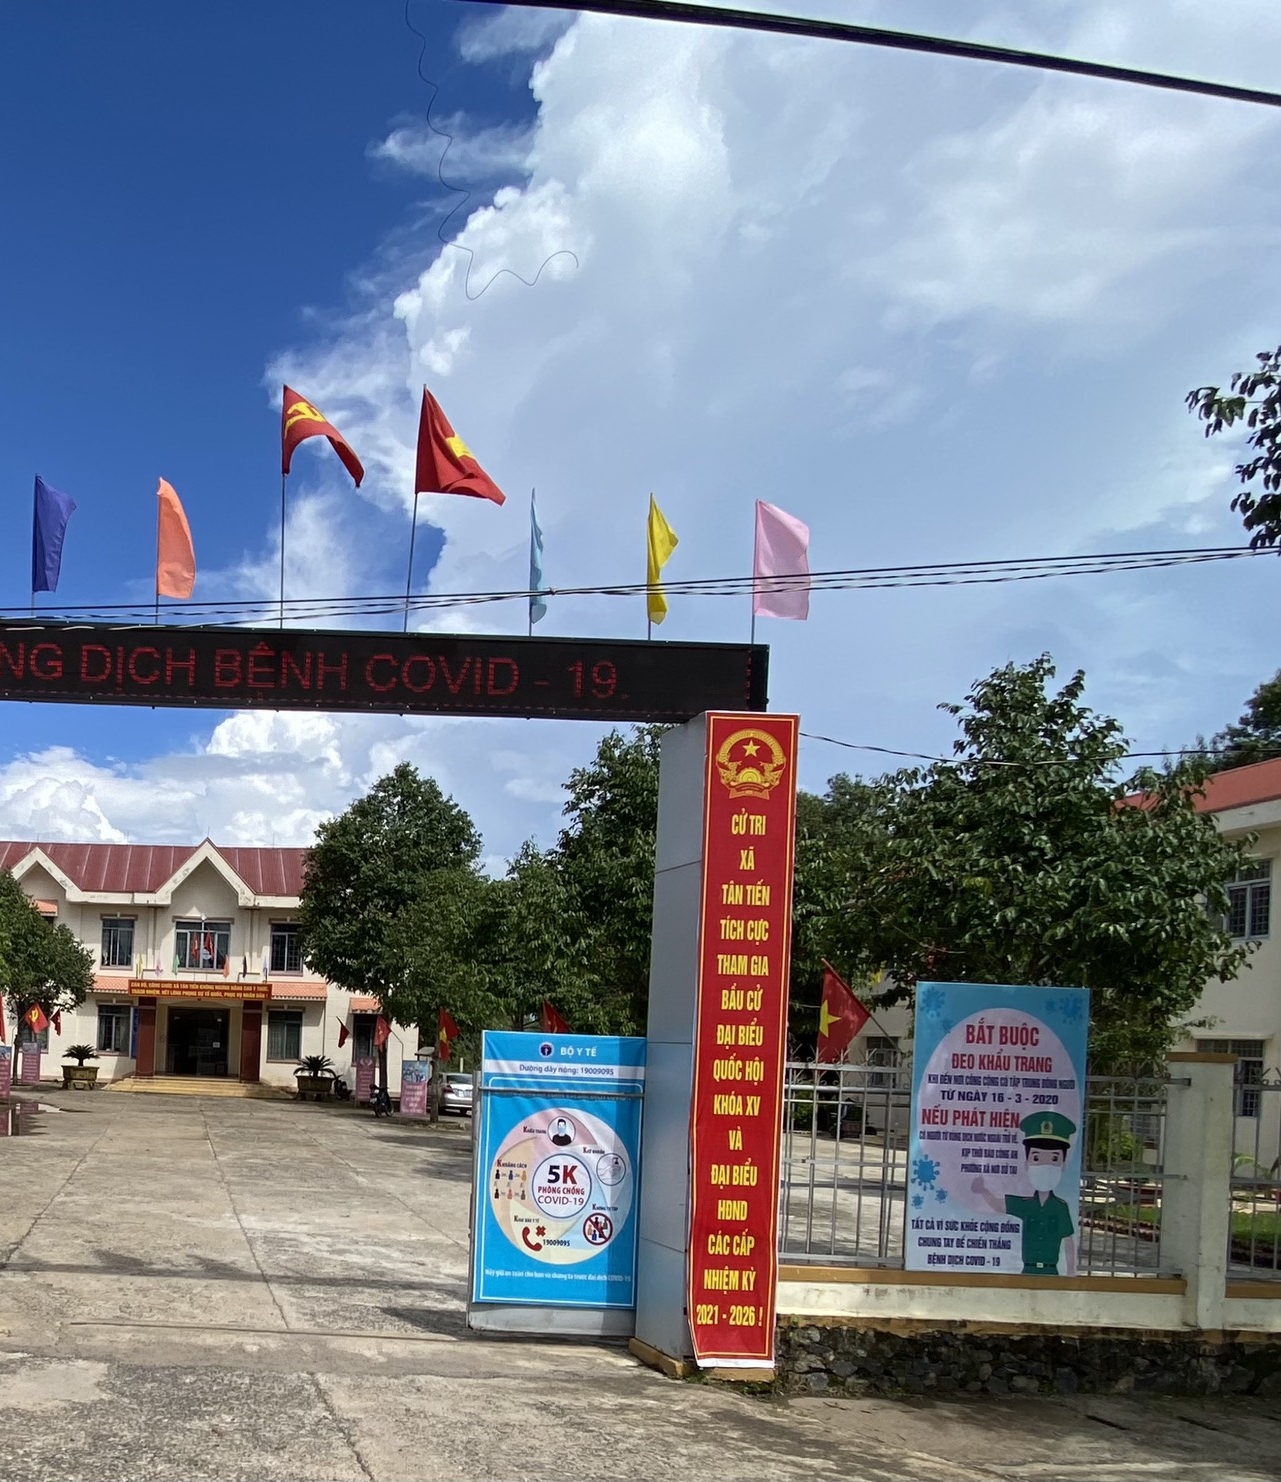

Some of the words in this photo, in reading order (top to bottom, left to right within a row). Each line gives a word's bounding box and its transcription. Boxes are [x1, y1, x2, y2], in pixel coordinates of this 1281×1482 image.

[81, 644, 195, 691] DỊCH
[214, 640, 348, 699] BỆNH
[366, 655, 519, 696] COVID
[731, 808, 748, 835] CỬ
[750, 815, 766, 835] TRI
[740, 847, 754, 870] XÃ
[722, 880, 743, 905] TÂN
[746, 879, 770, 906] TIẾN
[720, 915, 743, 940] TÍCH
[747, 918, 769, 945] CỰC
[718, 954, 747, 975] THAM
[751, 956, 769, 976] GIA
[721, 983, 743, 1010] BẦU
[747, 984, 763, 1011] CỬ
[717, 1025, 735, 1049] ĐẠI
[738, 1018, 763, 1046] BIỂU
[966, 1017, 994, 1044] BẮT
[999, 1023, 1039, 1050] BUỘC
[561, 1047, 574, 1058] BỘ
[577, 1048, 584, 1056] Y
[585, 1046, 597, 1057] TẾ
[952, 1053, 974, 1070] ĐEO
[979, 1049, 1010, 1070] KHẨU
[1015, 1056, 1052, 1072] TRANG
[713, 1052, 742, 1082] QUỐC
[745, 1057, 764, 1086] HỘI
[714, 1091, 742, 1115] KHÓA
[746, 1096, 760, 1116] XV
[941, 1090, 955, 1100] TỪ
[958, 1090, 987, 1102] NGÀY
[992, 1093, 1004, 1102] 16
[1015, 1094, 1021, 1103] 3
[1032, 1094, 1058, 1104] 2020
[922, 1104, 948, 1125] NẾU
[953, 1106, 986, 1127] PHÁT
[990, 1108, 1020, 1131] HIỆN
[729, 1126, 742, 1150] VÀ
[547, 1165, 577, 1184] 5K
[711, 1165, 729, 1189] ĐẠI
[732, 1158, 757, 1186] BIỂU
[538, 1186, 561, 1195] PHÒNG
[563, 1185, 584, 1195] CHỐNG
[538, 1195, 584, 1206] COVID-19
[717, 1200, 747, 1220] HĐND
[708, 1231, 730, 1255] CÁC
[733, 1228, 755, 1256] CẤP
[928, 1252, 946, 1266] BỆNH
[948, 1255, 964, 1267] DỊCH
[966, 1256, 985, 1265] COVID
[992, 1257, 1000, 1266] 19
[704, 1266, 738, 1294] NHIỆM
[742, 1267, 756, 1291] KỲ
[697, 1305, 718, 1324] 2021
[729, 1306, 755, 1326] 2026
